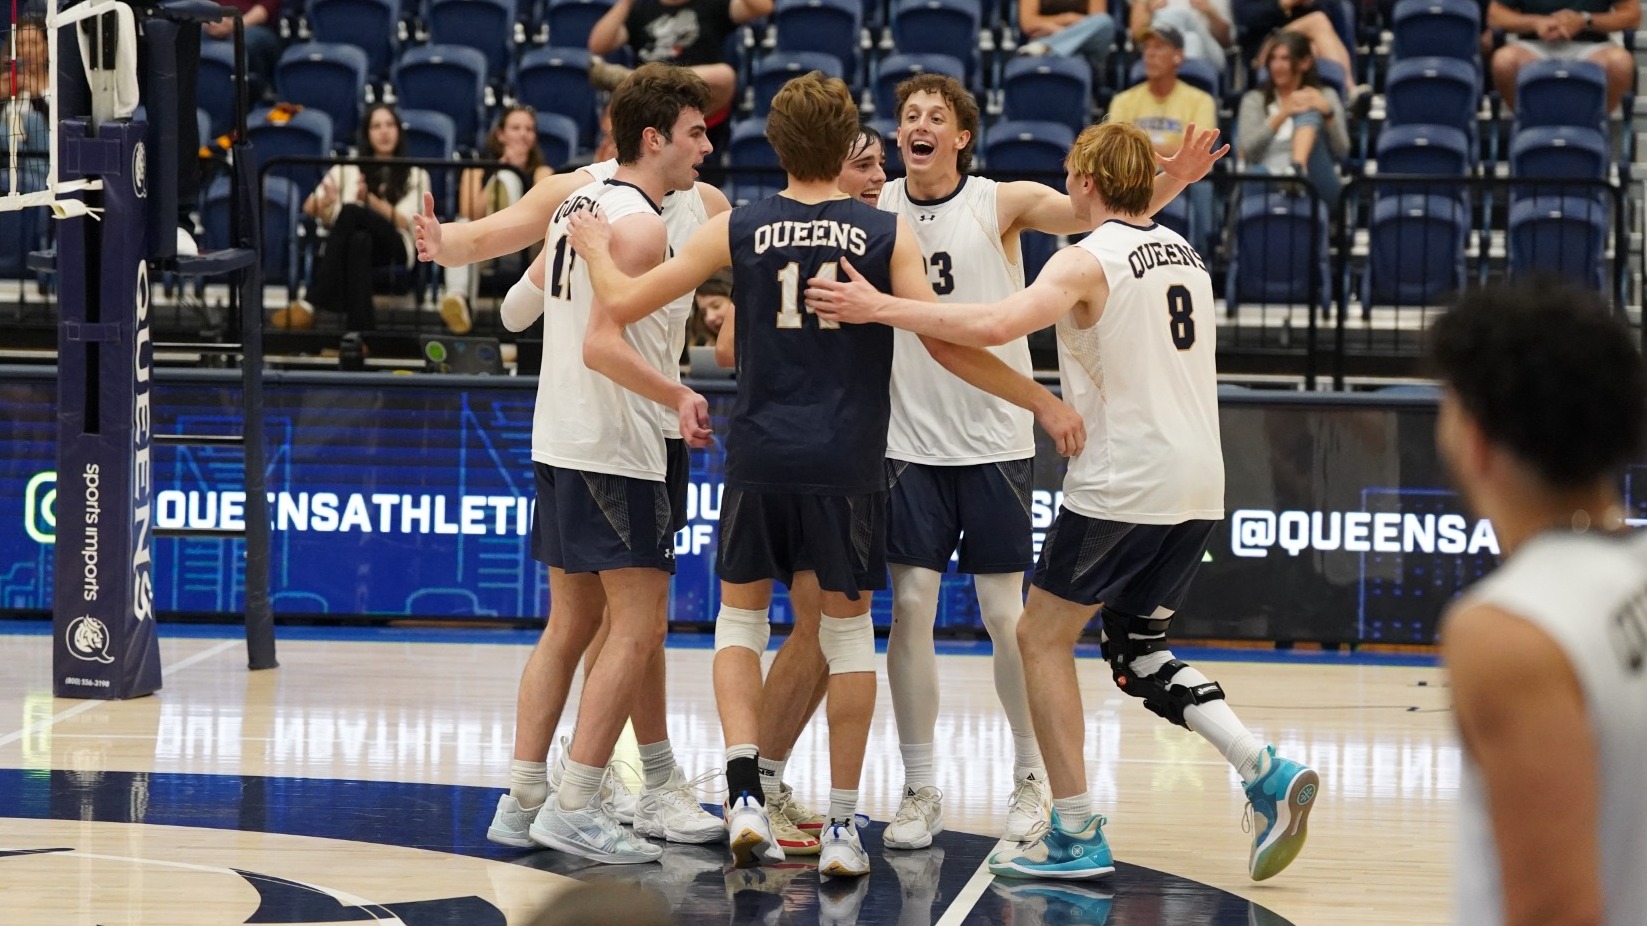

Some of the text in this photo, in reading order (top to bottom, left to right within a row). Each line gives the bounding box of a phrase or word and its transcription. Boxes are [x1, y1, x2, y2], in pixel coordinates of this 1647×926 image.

[754, 219, 867, 256] QUEENS
[923, 251, 955, 296] 3
[1166, 284, 1196, 352] 8
[133, 259, 154, 622] QUEENS
[81, 463, 101, 601] sports imports
